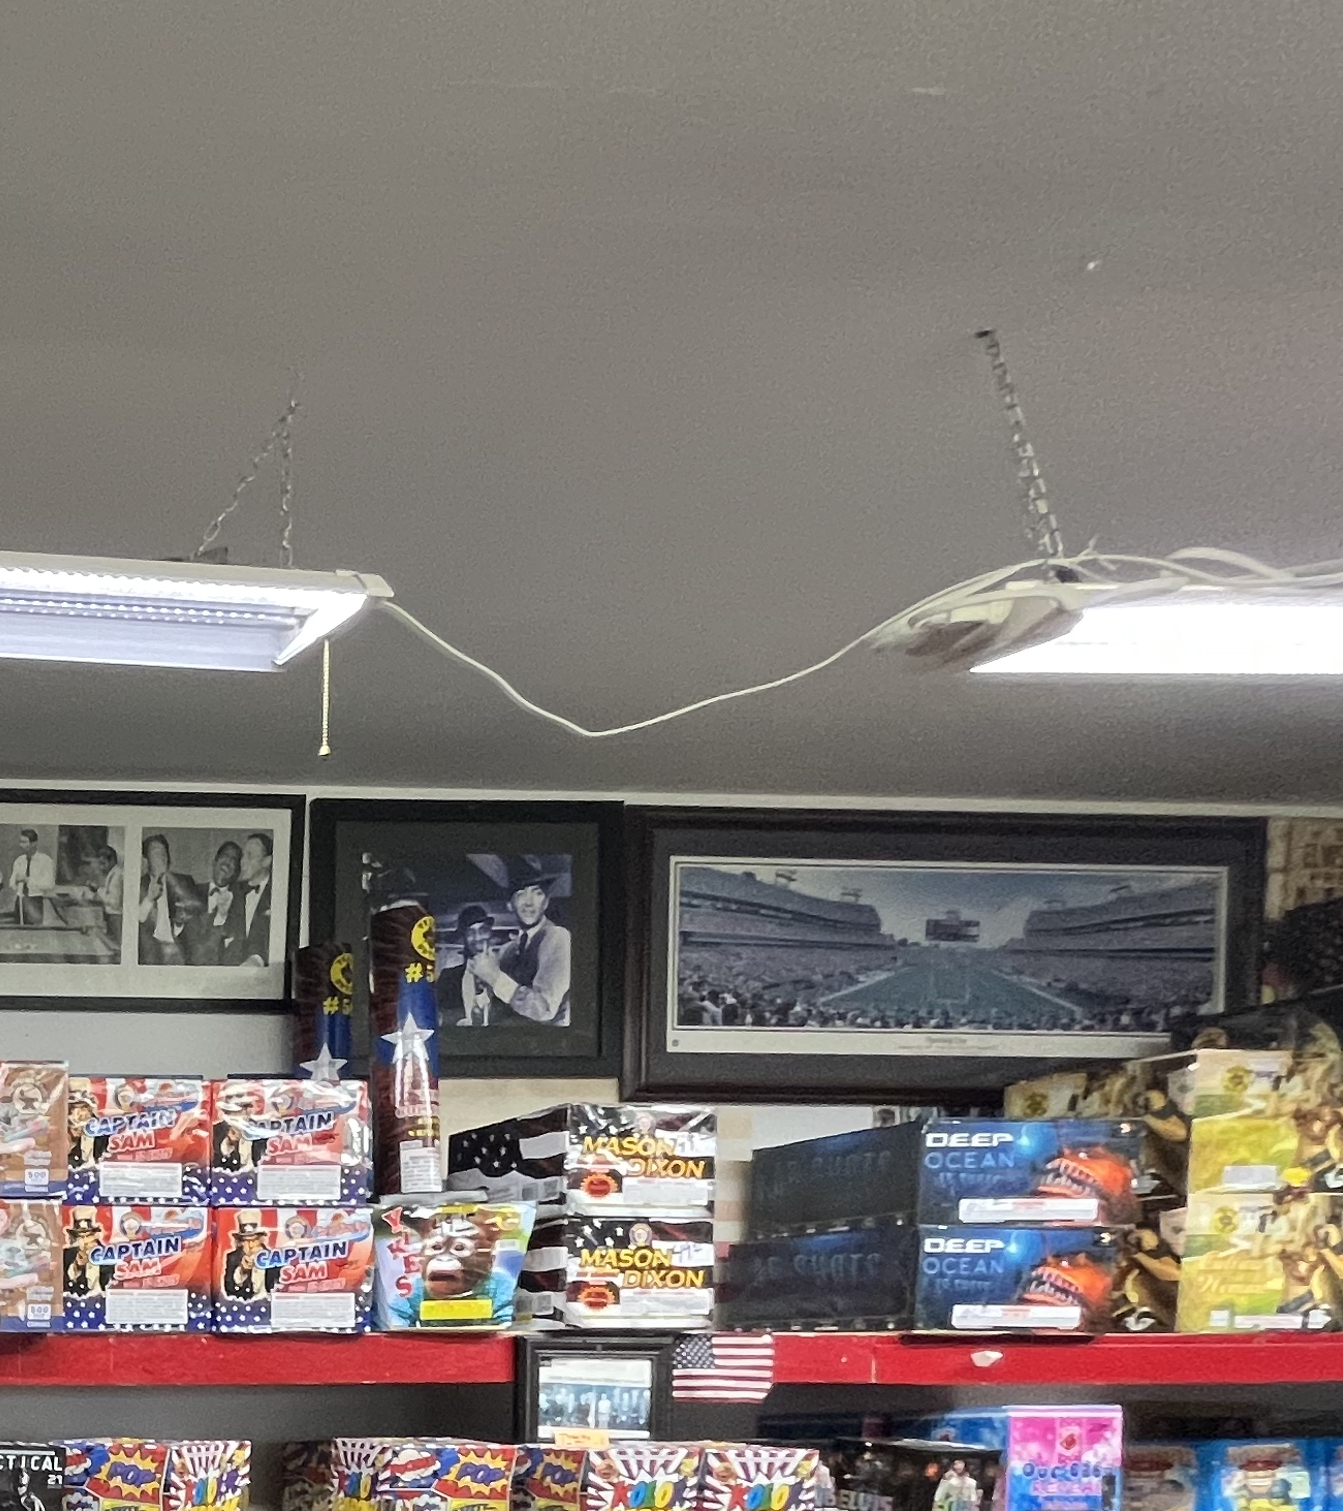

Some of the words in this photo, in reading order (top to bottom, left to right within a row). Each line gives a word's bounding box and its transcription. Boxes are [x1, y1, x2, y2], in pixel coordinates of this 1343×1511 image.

[90, 1237, 182, 1265] CAPTAIN
[256, 1241, 348, 1268] CAPTAIN
[580, 1249, 672, 1269] MASON
[115, 1259, 162, 1281] SAM
[279, 1262, 328, 1284] SAM
[623, 1270, 705, 1289] DIXON
